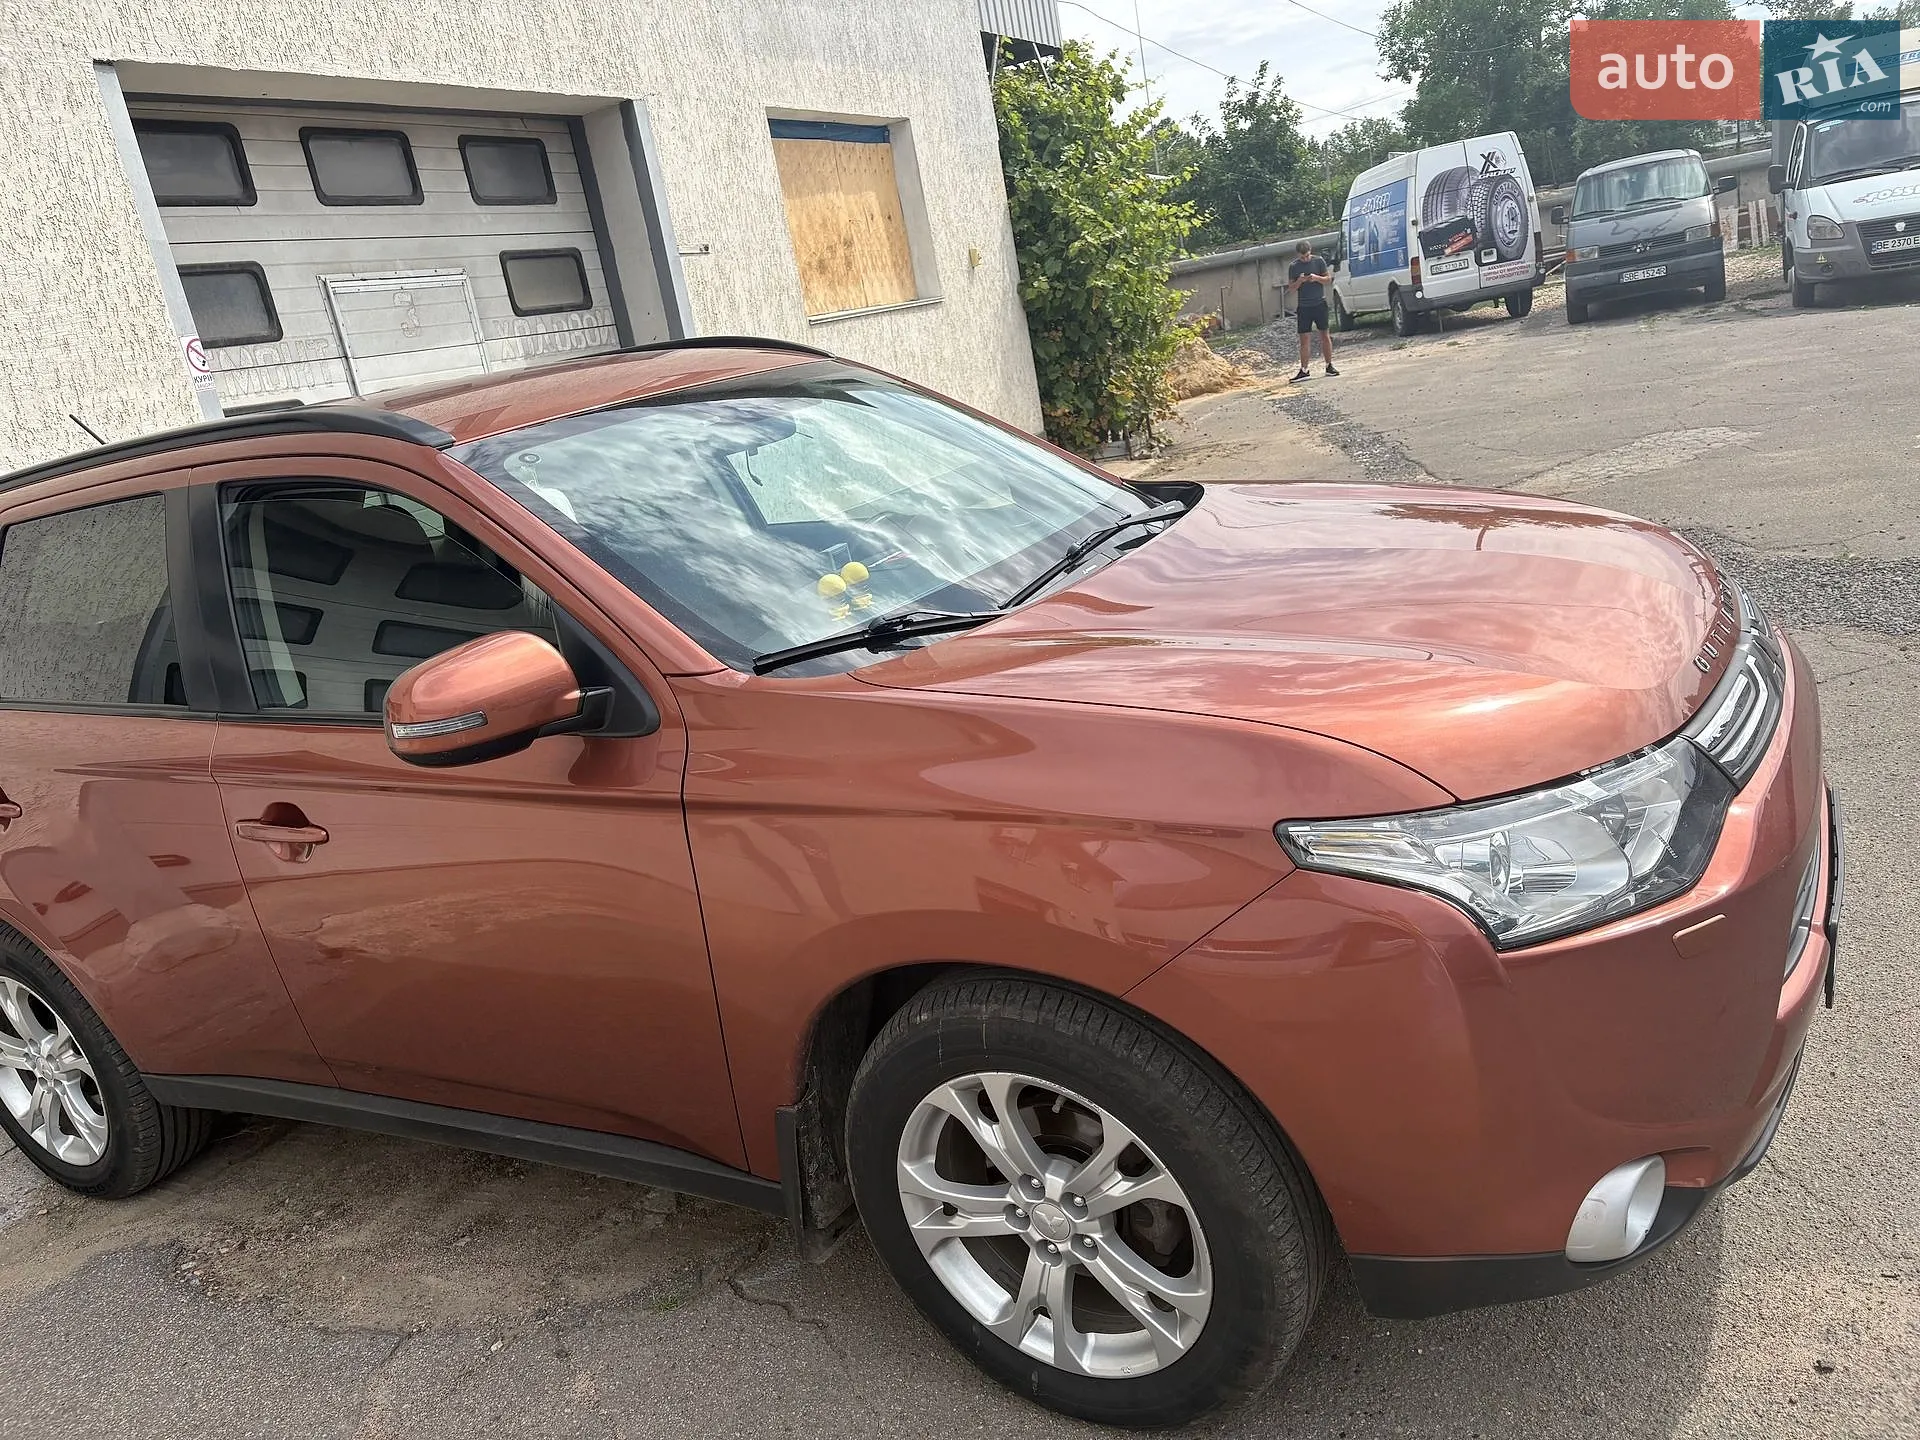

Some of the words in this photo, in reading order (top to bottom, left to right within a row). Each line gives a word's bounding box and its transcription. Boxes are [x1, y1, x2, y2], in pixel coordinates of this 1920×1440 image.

[1877, 240, 1889, 250] BE
[1891, 237, 1912, 248] 2370
[1624, 271, 1640, 281] SBE
